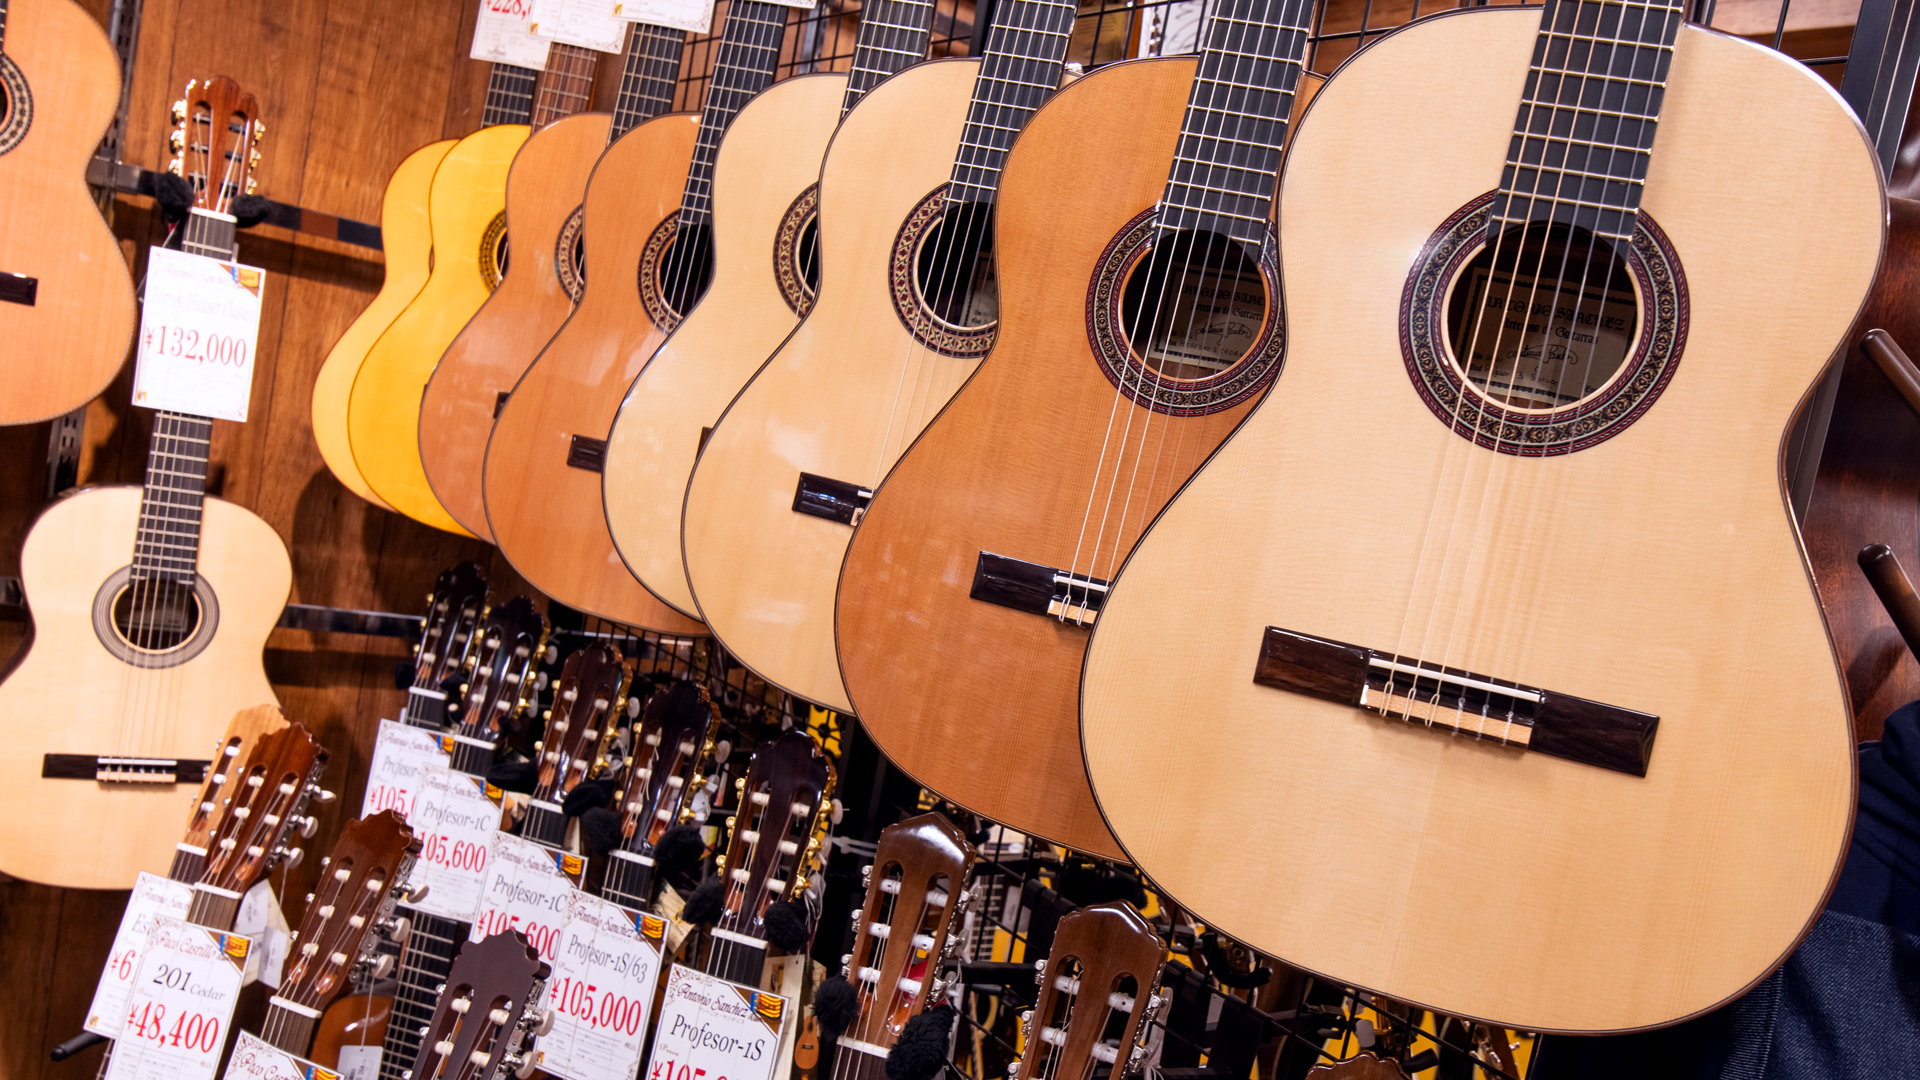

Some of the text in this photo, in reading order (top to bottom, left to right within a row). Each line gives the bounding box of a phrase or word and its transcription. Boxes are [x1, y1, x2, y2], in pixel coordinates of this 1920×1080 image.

[1555, 306, 1627, 331] SANCHEZ
[145, 325, 247, 368] ¥132,000
[423, 801, 491, 832] Profesor-1C
[416, 832, 486, 873] 105,600
[493, 874, 568, 913] Profesor-1C
[132, 913, 151, 936] Es
[573, 905, 602, 927] Antonio
[602, 916, 634, 938] Sanchez
[567, 934, 648, 984] Profesor-1S/63
[152, 963, 226, 1000] 201 Cedar
[677, 983, 748, 1018] Antonio Sanchez
[550, 977, 642, 1036] ¥105,000
[127, 1000, 219, 1054] ¥48,400
[670, 1014, 765, 1061] Profesor-1S
[239, 1052, 264, 1076] Paco
